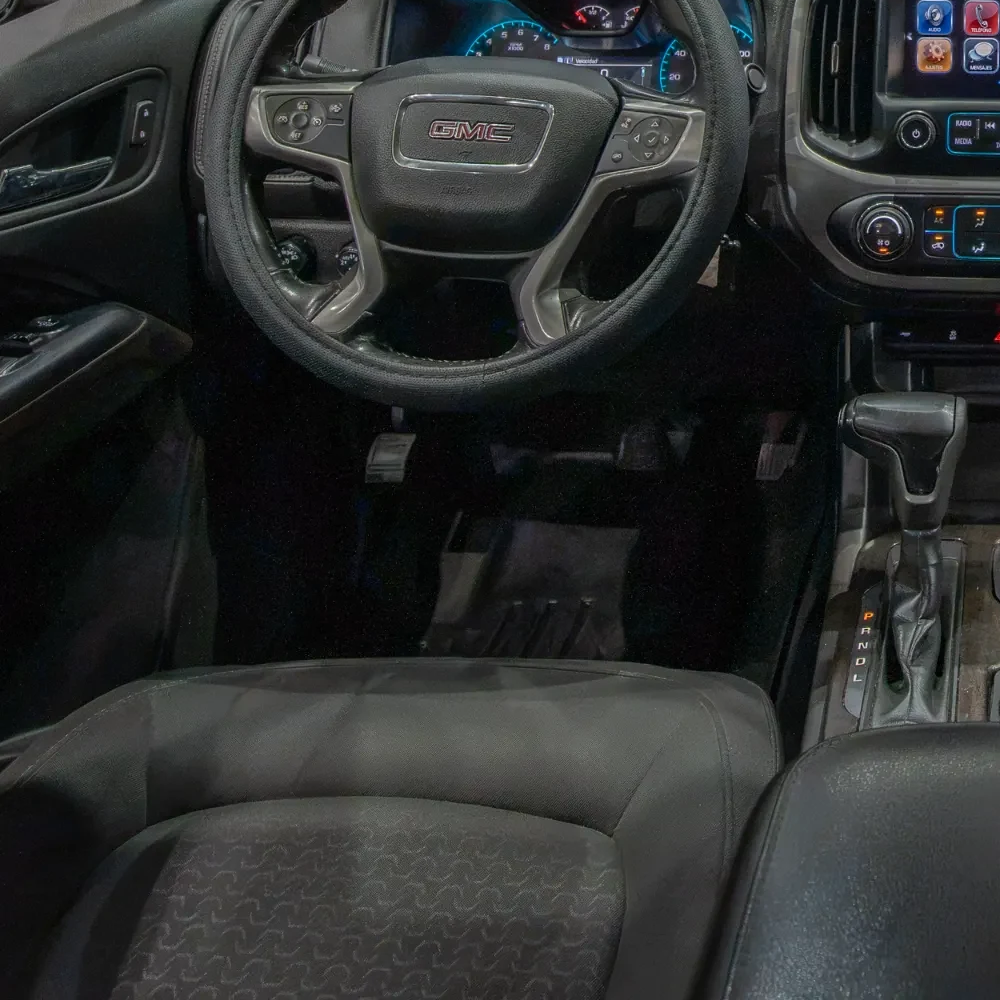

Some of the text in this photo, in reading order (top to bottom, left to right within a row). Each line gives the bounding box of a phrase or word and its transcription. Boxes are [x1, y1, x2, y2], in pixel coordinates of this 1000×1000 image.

[501, 31, 508, 39] 5
[533, 34, 540, 42] 7
[543, 43, 550, 51] 8
[669, 73, 681, 81] 20
[955, 119, 973, 128] RADIO
[428, 119, 515, 143] GMC
[954, 137, 973, 146] MEDIA
[863, 611, 874, 620] P
[861, 627, 871, 635] R
[857, 641, 868, 649] N
[855, 657, 866, 666] D
[853, 674, 862, 682] L
